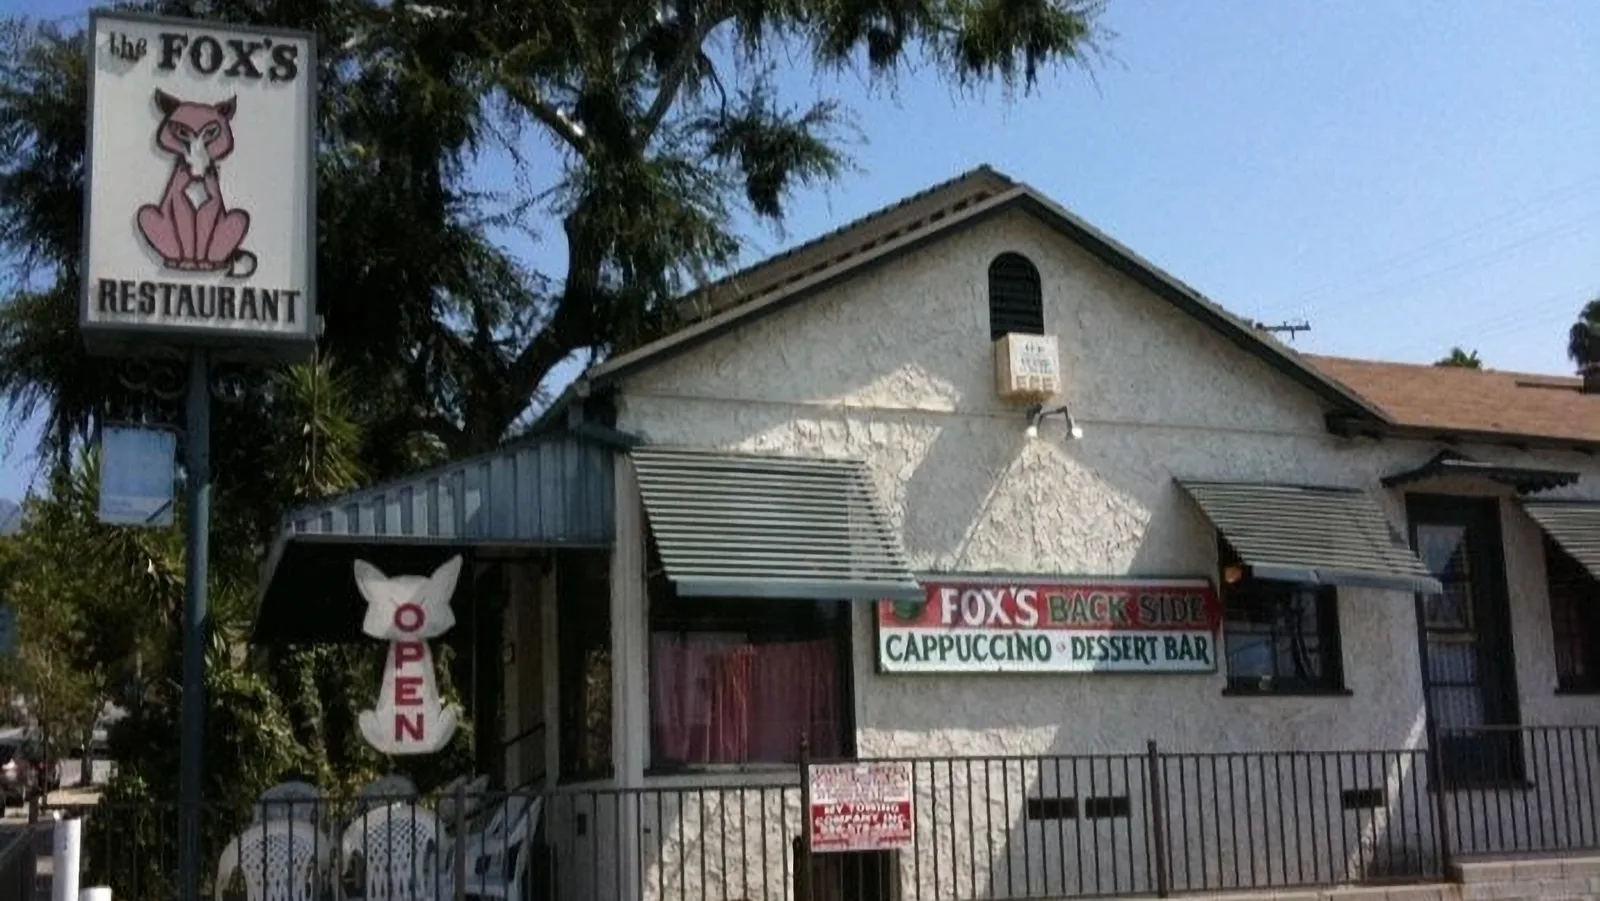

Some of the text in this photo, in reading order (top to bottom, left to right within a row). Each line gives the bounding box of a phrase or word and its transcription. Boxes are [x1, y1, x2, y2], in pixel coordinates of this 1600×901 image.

[108, 31, 298, 83] the FOX'S
[97, 278, 301, 323] RESTAURANT
[940, 587, 1208, 626] FOX'S BACK SIDE
[885, 631, 1210, 665] CAPPUCCINO DESSERT BAR
[394, 602, 425, 742] OPEN
